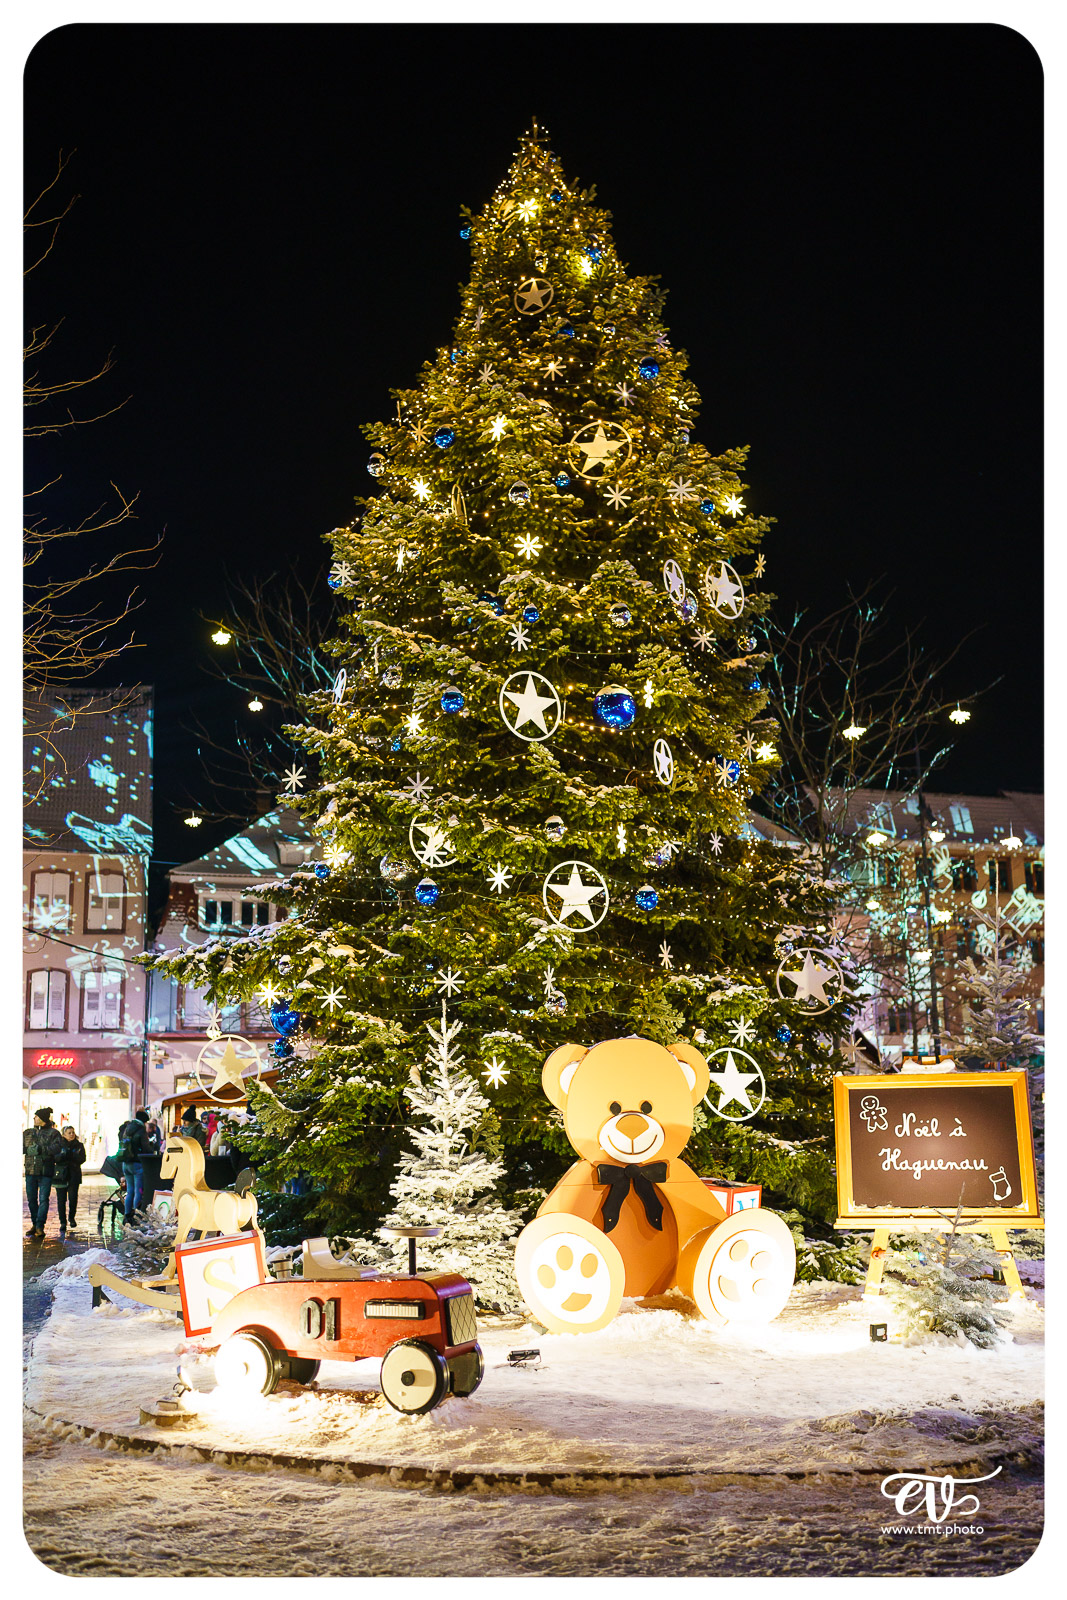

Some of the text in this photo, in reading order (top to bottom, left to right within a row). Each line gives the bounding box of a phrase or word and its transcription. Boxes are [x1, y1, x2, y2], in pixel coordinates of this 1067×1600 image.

[37, 1054, 74, 1066] Etam
[948, 1117, 967, 1137] à
[878, 1147, 989, 1180] Haguenau
[203, 1255, 240, 1317] S
[300, 1299, 336, 1341] 01
